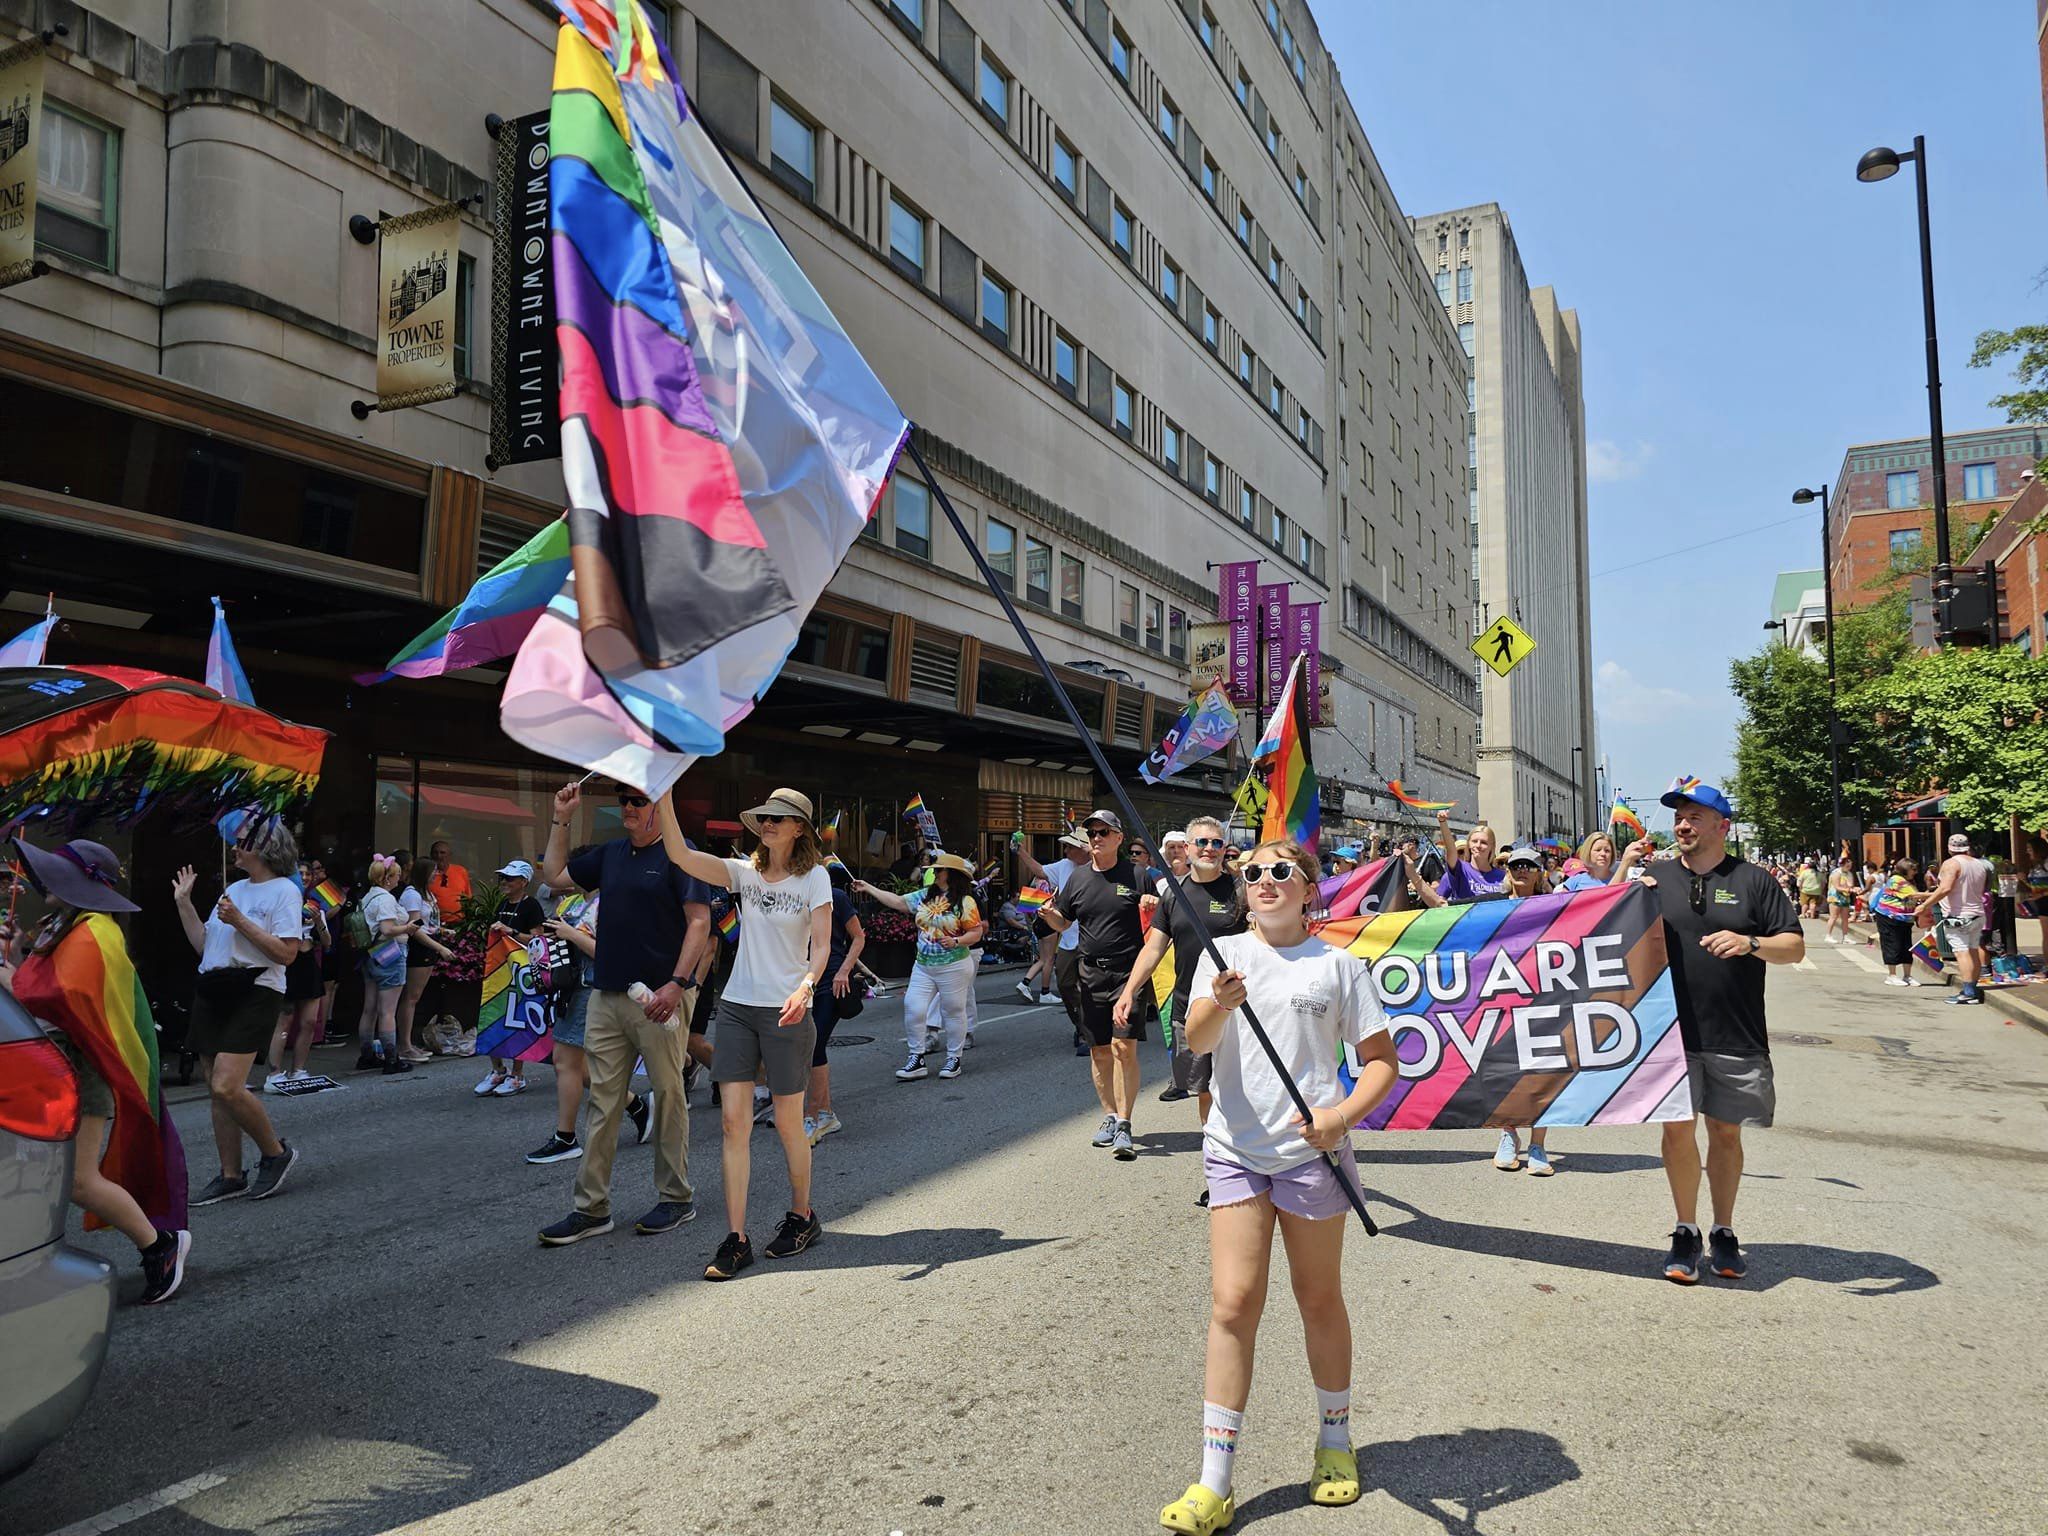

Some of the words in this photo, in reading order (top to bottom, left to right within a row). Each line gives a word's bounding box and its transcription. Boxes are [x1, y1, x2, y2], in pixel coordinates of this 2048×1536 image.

[521, 122, 550, 329] DOWNTOWNE
[388, 319, 444, 351] TOWNE
[388, 341, 444, 367] PROPERTIES
[520, 349, 544, 448] LIVING
[1238, 566, 1247, 577] THE
[1237, 581, 1249, 612] LOFTS
[1269, 588, 1278, 599] THE
[1270, 602, 1281, 630] LOFTS
[1236, 625, 1249, 668] SHILLITO
[1300, 619, 1312, 646] LOFTS
[1196, 664, 1225, 674] TOWNE
[1270, 642, 1282, 682] SHILLITO
[1363, 951, 1468, 1006] OU
[1480, 933, 1630, 998] ARE
[1204, 1437, 1235, 1454] INS
